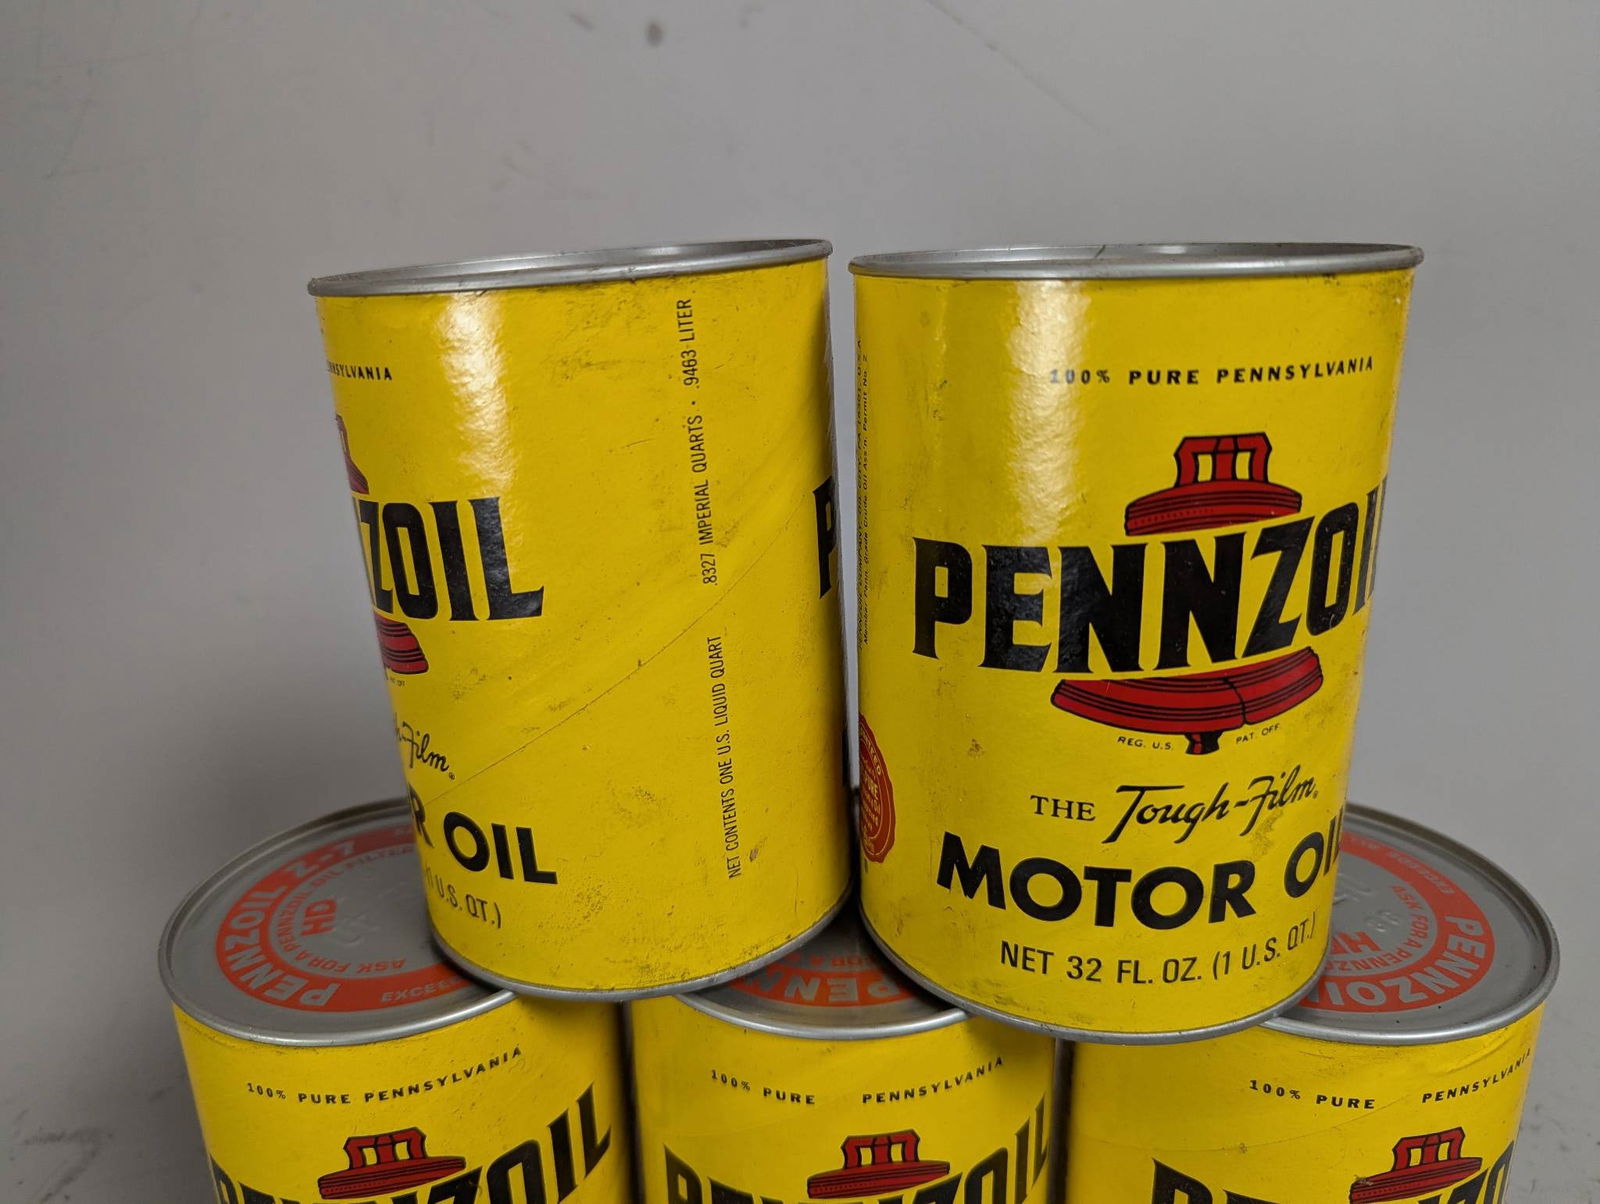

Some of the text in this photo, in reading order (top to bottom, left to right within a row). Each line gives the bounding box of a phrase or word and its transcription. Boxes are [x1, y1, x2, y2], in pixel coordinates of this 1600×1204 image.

[1050, 355, 1375, 386] 100% PURE PENNSYLVANIA
[676, 299, 718, 586] .8327 IMPERIAL QUARTS .9463 LITER
[352, 496, 545, 621] ZOIL
[911, 474, 1387, 675] PENNZOI
[707, 636, 743, 880] NET CONTENTS ONE U.S. LIQUID QUART
[1117, 735, 1146, 749] REG.
[1030, 794, 1097, 823] THE
[443, 811, 558, 885] OIL
[435, 874, 463, 911] U.S.
[465, 894, 502, 929] QT.)
[936, 831, 1257, 931] MOTOR
[301, 899, 337, 937] HD
[1403, 940, 1423, 950] A
[1411, 913, 1430, 940] FOR
[224, 885, 342, 1007] PENNZOIL
[295, 950, 309, 961] A
[308, 960, 352, 973] FOR
[355, 957, 407, 974] ASK
[1000, 911, 1317, 985] NET 32 FL. OZ. (1 U.S. QT.)
[246, 1046, 523, 1105] 100% PURE PENNSYLVANIA
[711, 1056, 1005, 1106] 100% PURE PENNSYLVANIA
[1249, 1046, 1531, 1110] 100% PURE PENNSYLVANIA
